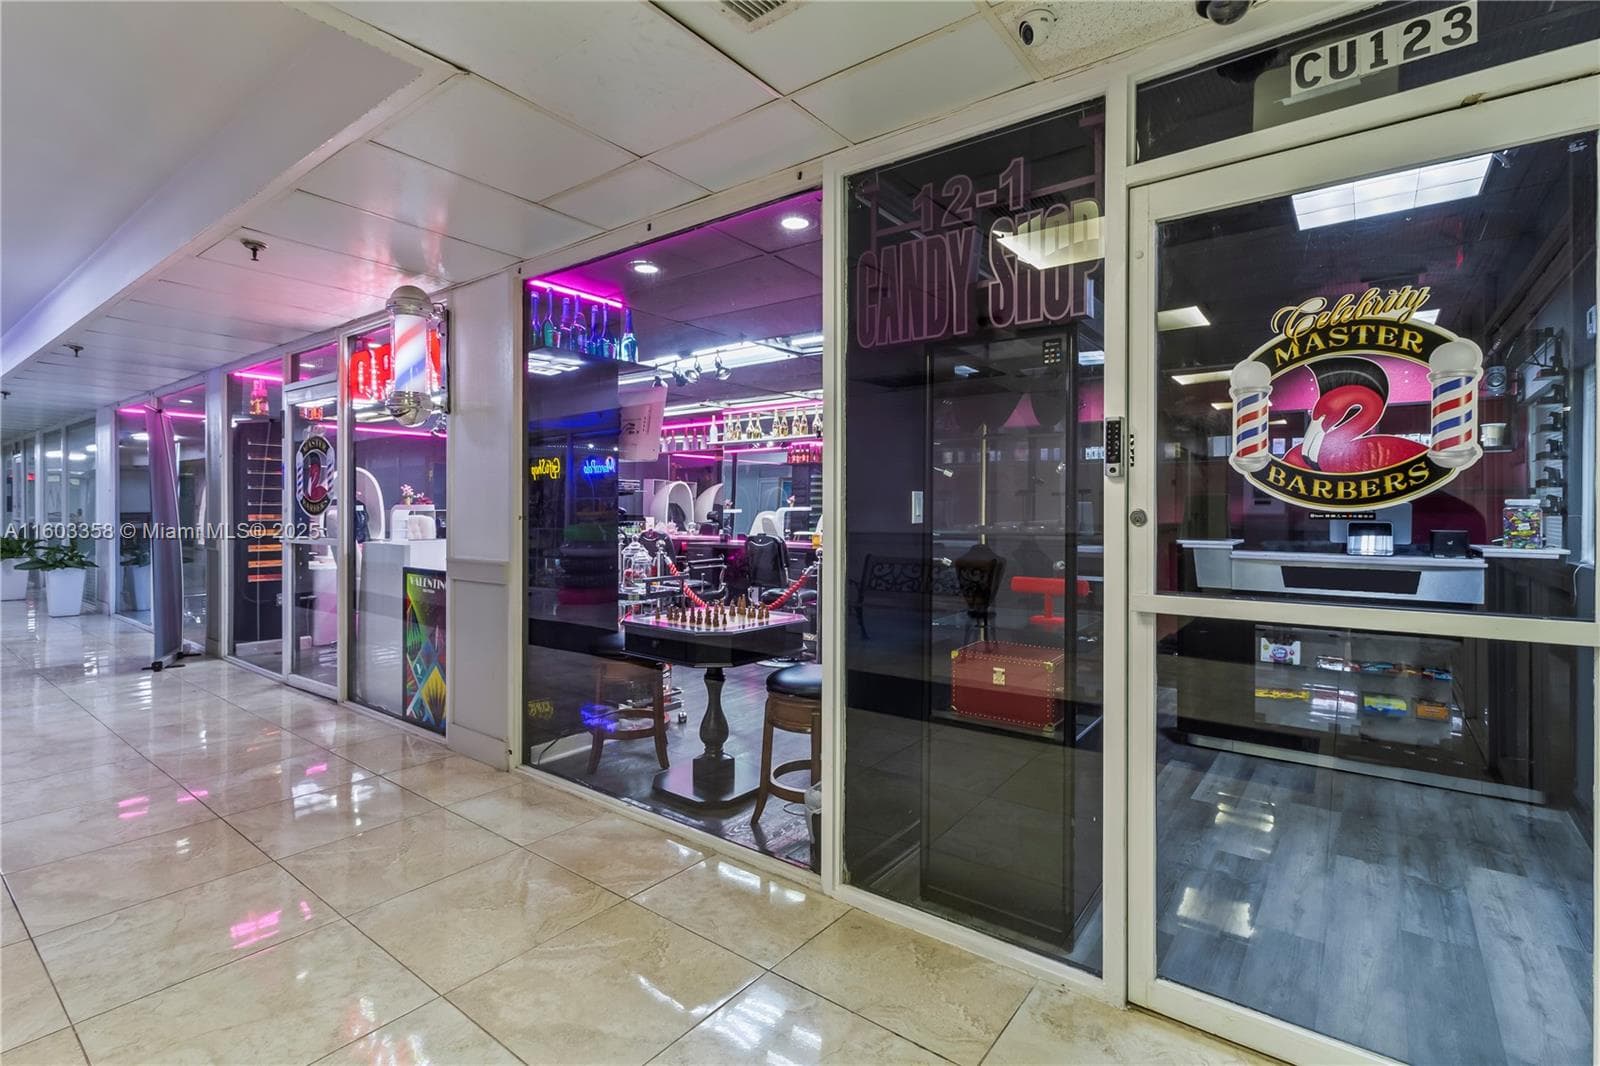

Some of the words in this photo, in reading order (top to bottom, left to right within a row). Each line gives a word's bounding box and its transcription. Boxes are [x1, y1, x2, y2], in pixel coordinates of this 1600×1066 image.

[1295, 5, 1473, 90] CU123
[913, 156, 1025, 232] 12-1
[856, 225, 977, 349] CANDY
[988, 199, 1099, 328] SHOP
[1271, 284, 1431, 342] Celebrity
[1273, 324, 1424, 368] MASTER
[1266, 460, 1431, 501] BARBERS
